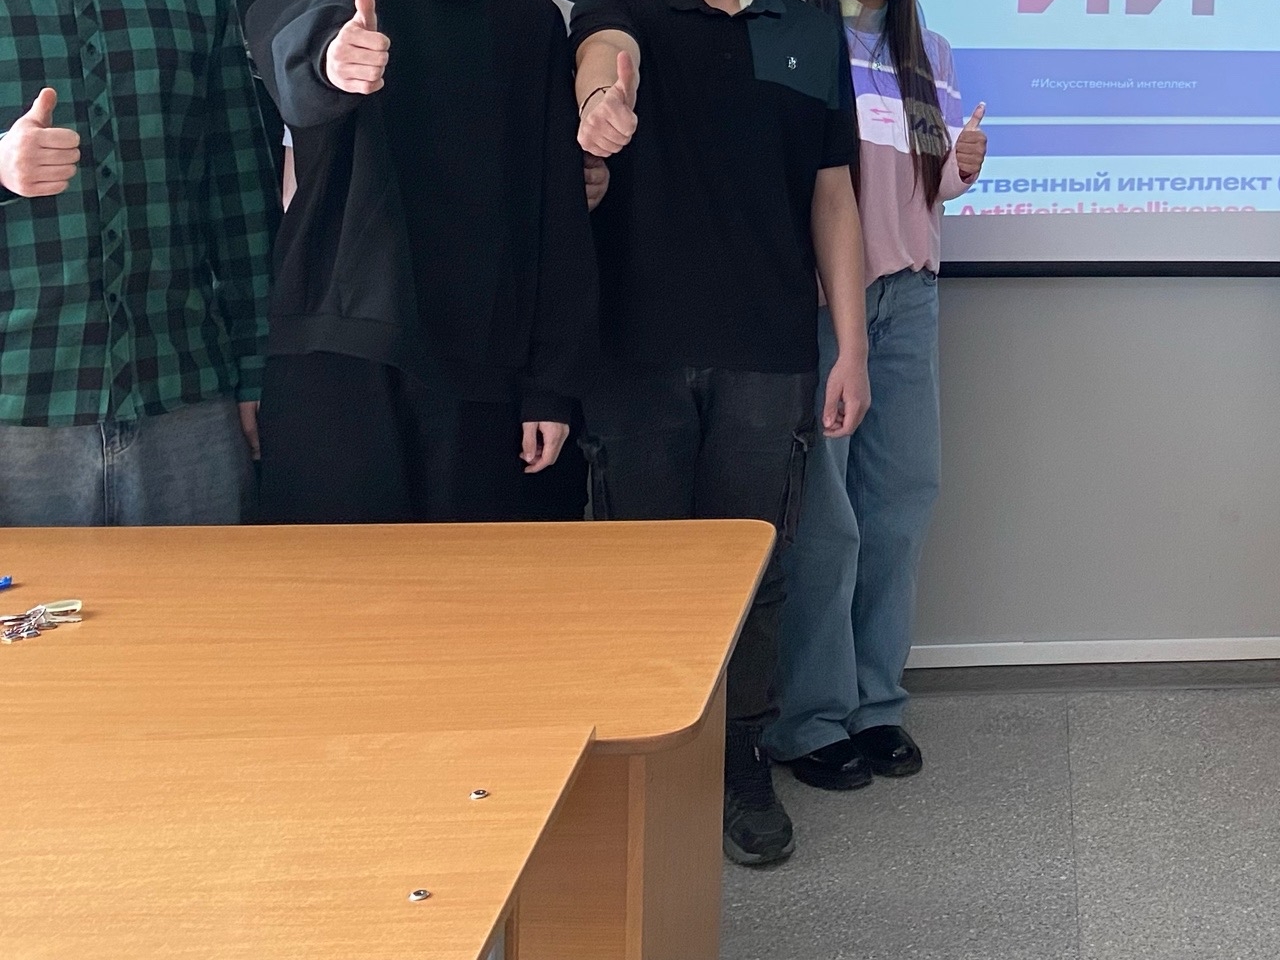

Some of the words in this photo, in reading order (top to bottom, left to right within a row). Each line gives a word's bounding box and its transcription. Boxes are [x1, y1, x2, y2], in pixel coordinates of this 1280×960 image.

[1031, 77, 1134, 91] #Искусственный
[1137, 78, 1198, 89] интеллект
[1118, 174, 1272, 192] интеллект
